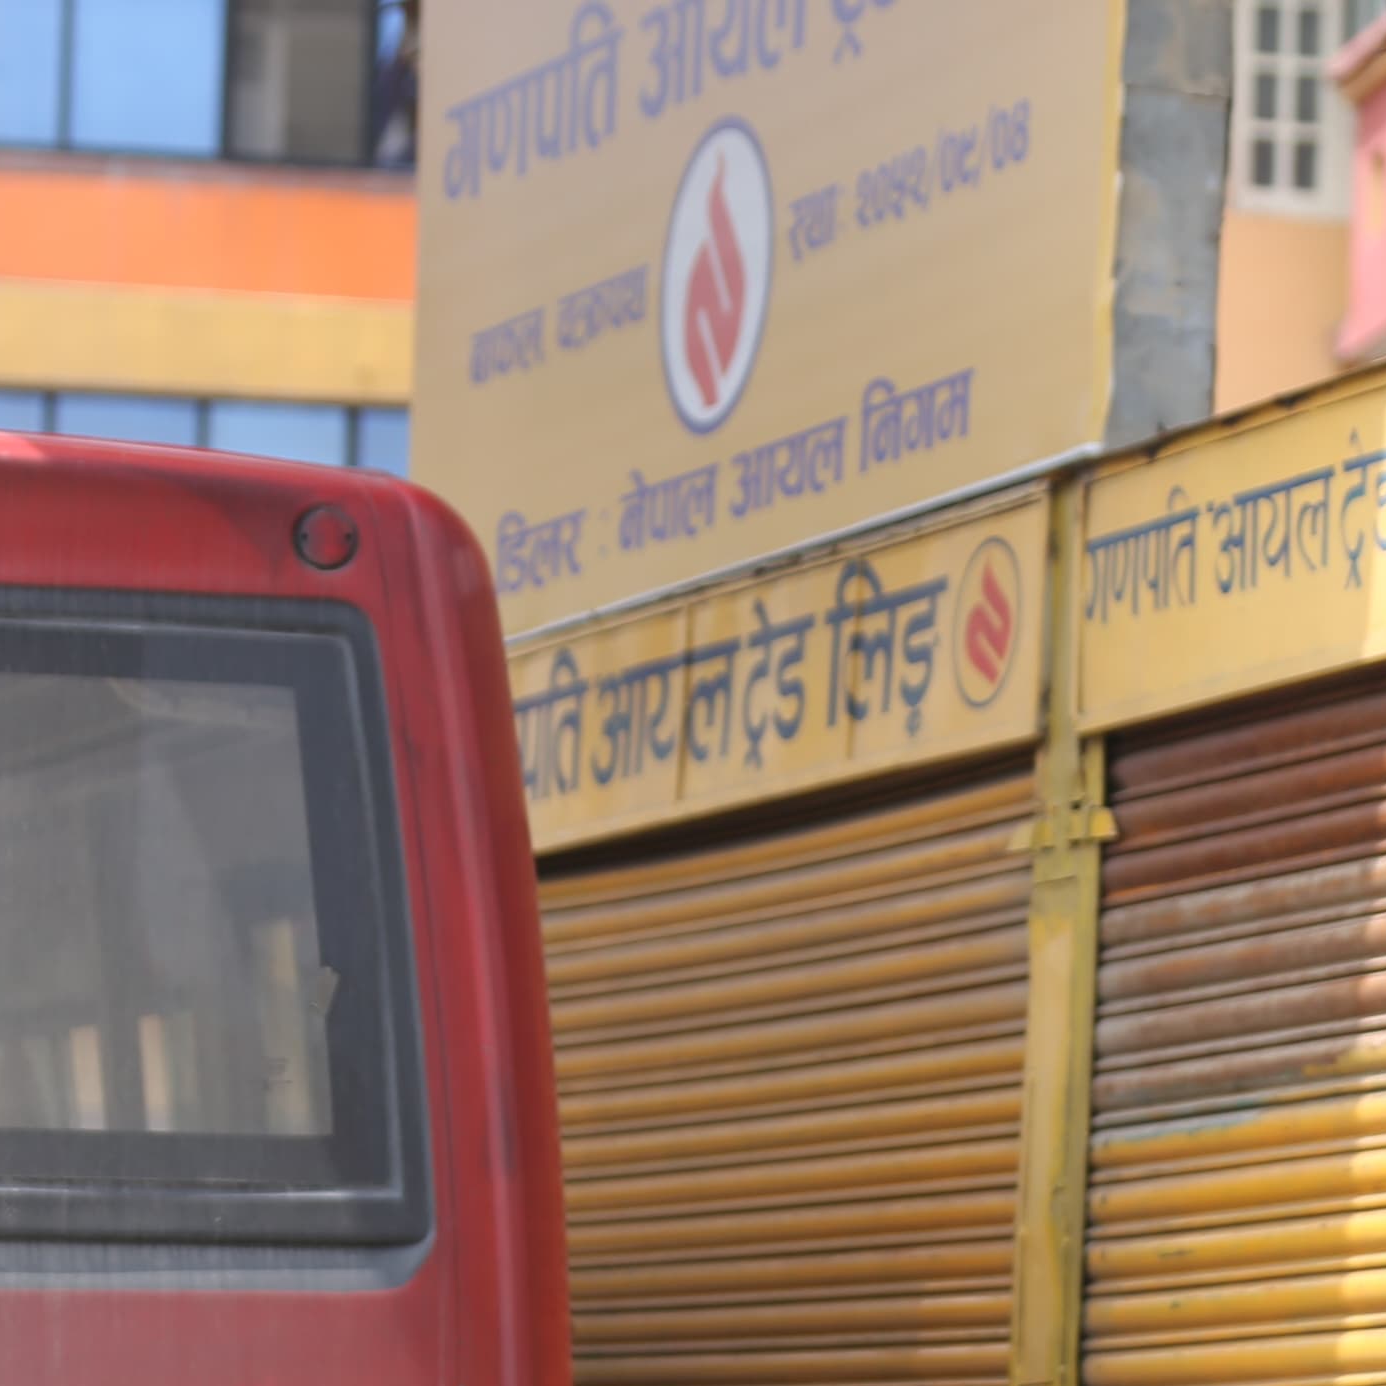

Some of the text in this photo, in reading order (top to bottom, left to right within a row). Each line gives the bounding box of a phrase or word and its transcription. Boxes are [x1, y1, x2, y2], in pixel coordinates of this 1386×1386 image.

[444, 0, 623, 201] गणपति
[619, 468, 720, 553] नेपाल
[727, 415, 849, 519] आयल
[858, 367, 974, 474] निगम
[1086, 484, 1202, 624] गणपति
[1207, 464, 1337, 595] आयल
[590, 633, 743, 788] आयल
